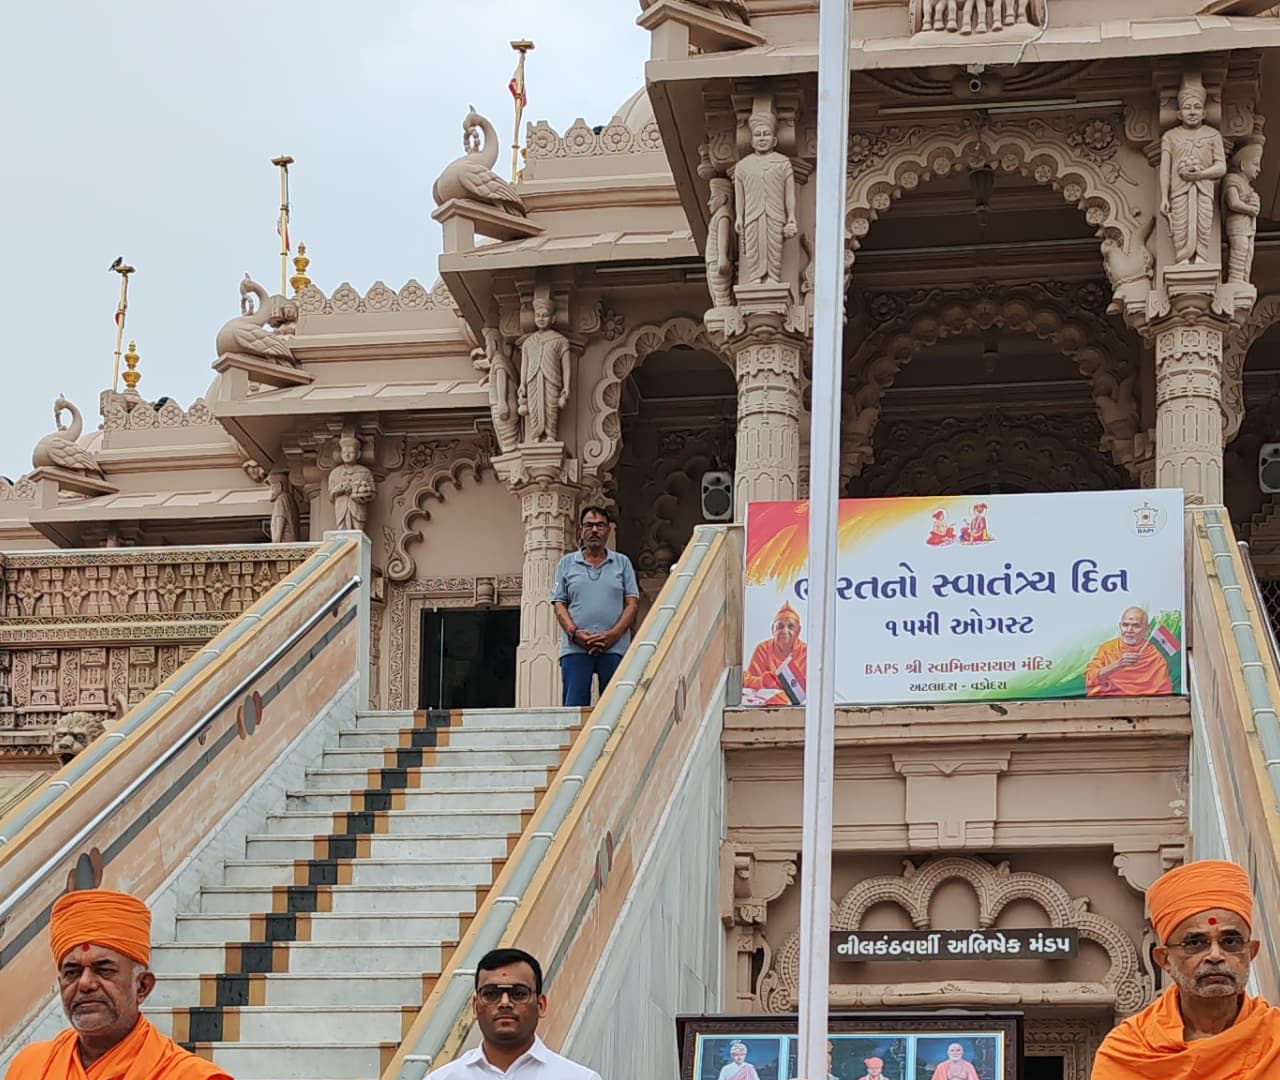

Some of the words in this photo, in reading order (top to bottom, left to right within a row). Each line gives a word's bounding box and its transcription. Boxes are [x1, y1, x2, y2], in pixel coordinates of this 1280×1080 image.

[1071, 559, 1129, 593] દિન
[950, 608, 1034, 635] ઓગસ્ટ
[865, 662, 899, 674] BAPS
[905, 659, 922, 674] શ્રી
[928, 658, 1016, 673] સ્વામિનારાયણ
[1021, 656, 1053, 671] મંદિર
[909, 681, 957, 692] અટલાદરા
[970, 678, 1008, 691] વડોદરા
[837, 934, 940, 956] નીલકંઠવર્ણી
[947, 933, 1021, 954] અભિષેક
[1029, 932, 1070, 952] મંડપ
